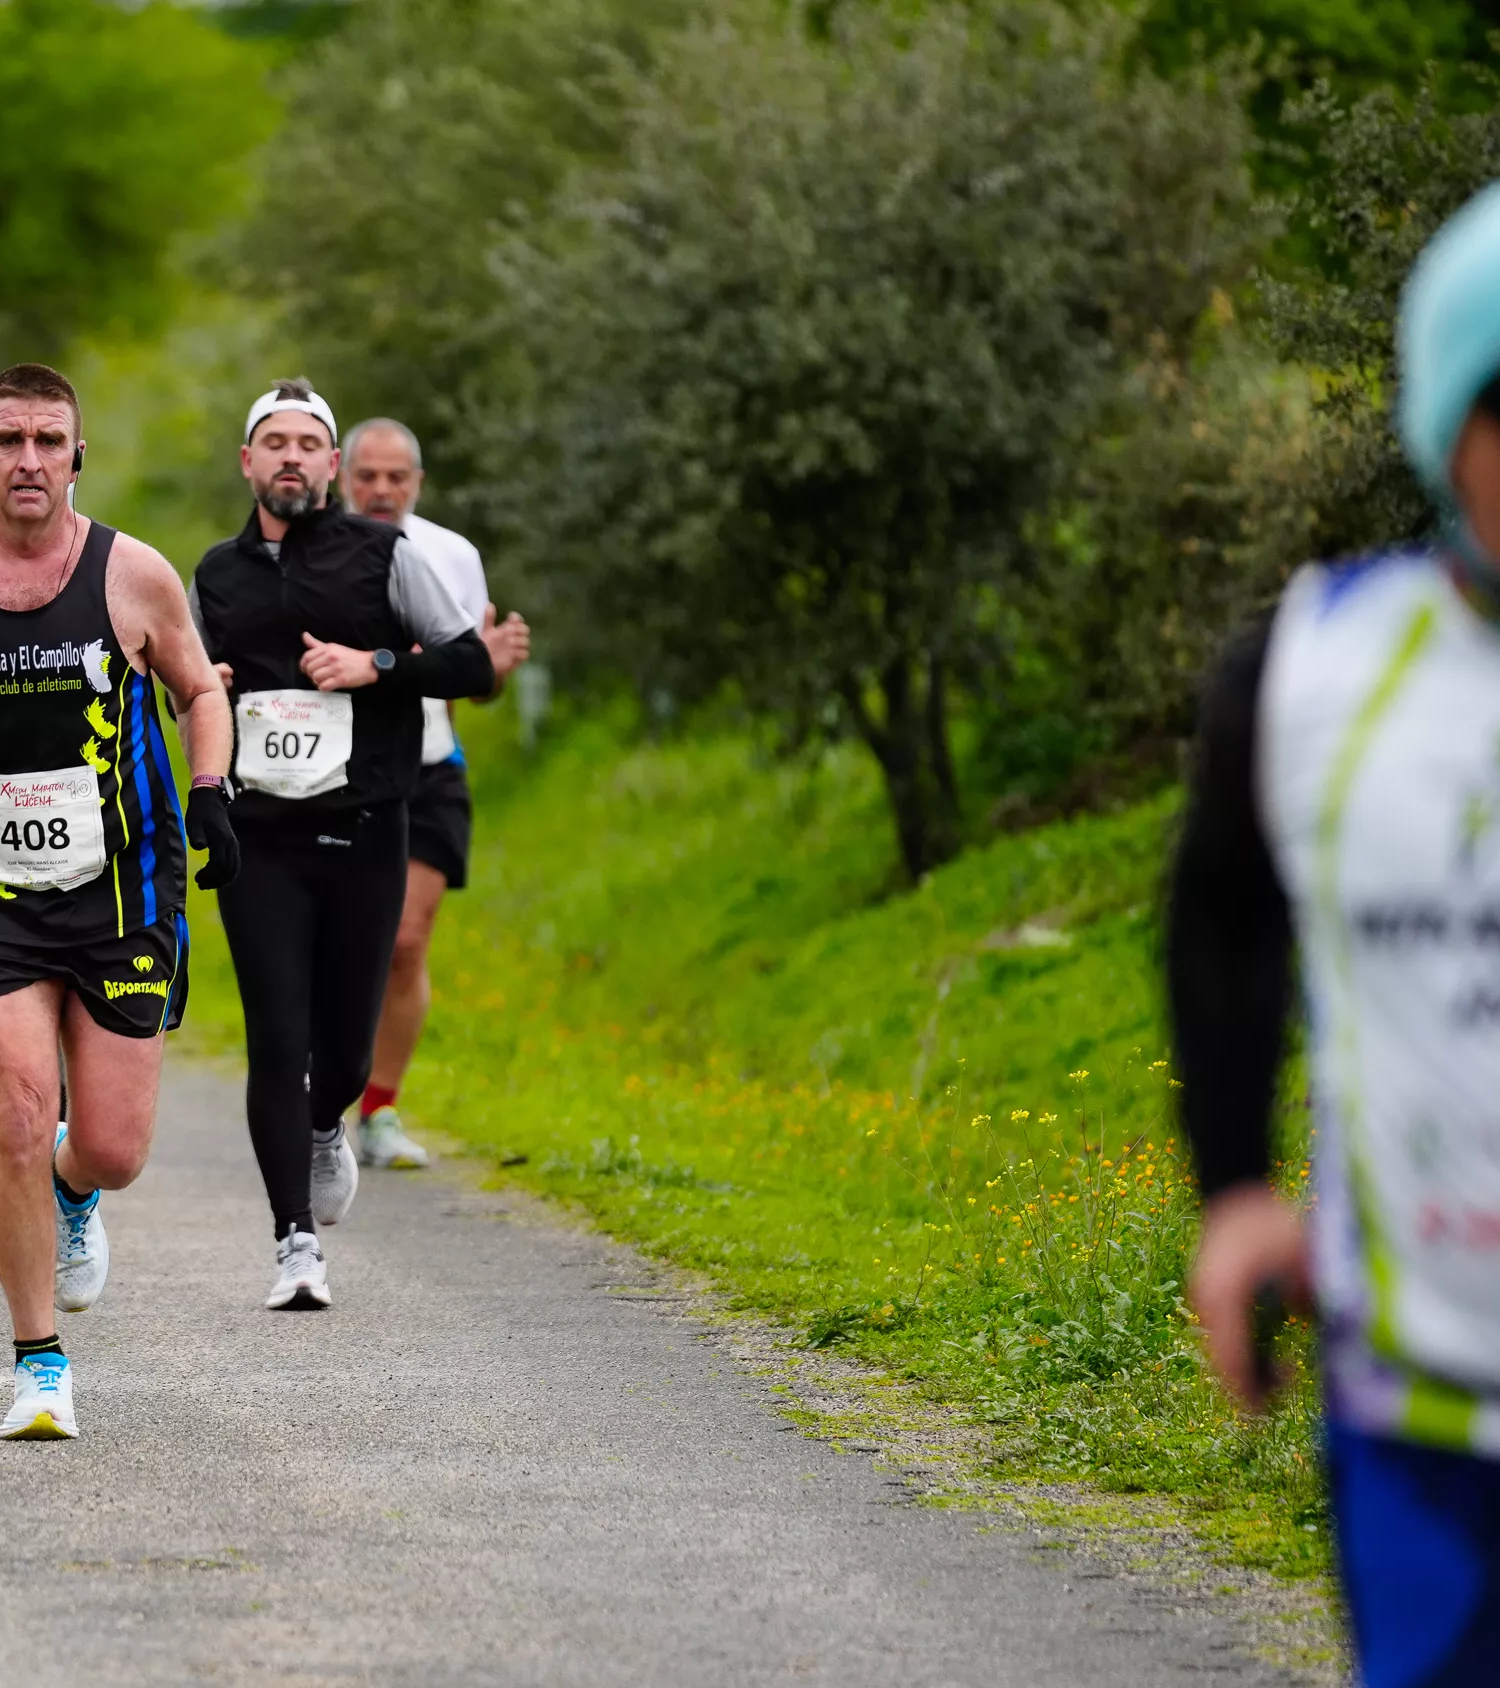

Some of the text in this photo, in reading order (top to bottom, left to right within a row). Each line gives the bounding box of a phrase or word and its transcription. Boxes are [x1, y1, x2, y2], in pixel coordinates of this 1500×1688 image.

[10, 653, 17, 676] y
[19, 645, 30, 670] El
[33, 641, 79, 674] Campillo
[0, 677, 82, 695] club de atletismo
[265, 731, 322, 759] 607
[15, 795, 54, 807] LUCENA
[1, 817, 71, 852] 408
